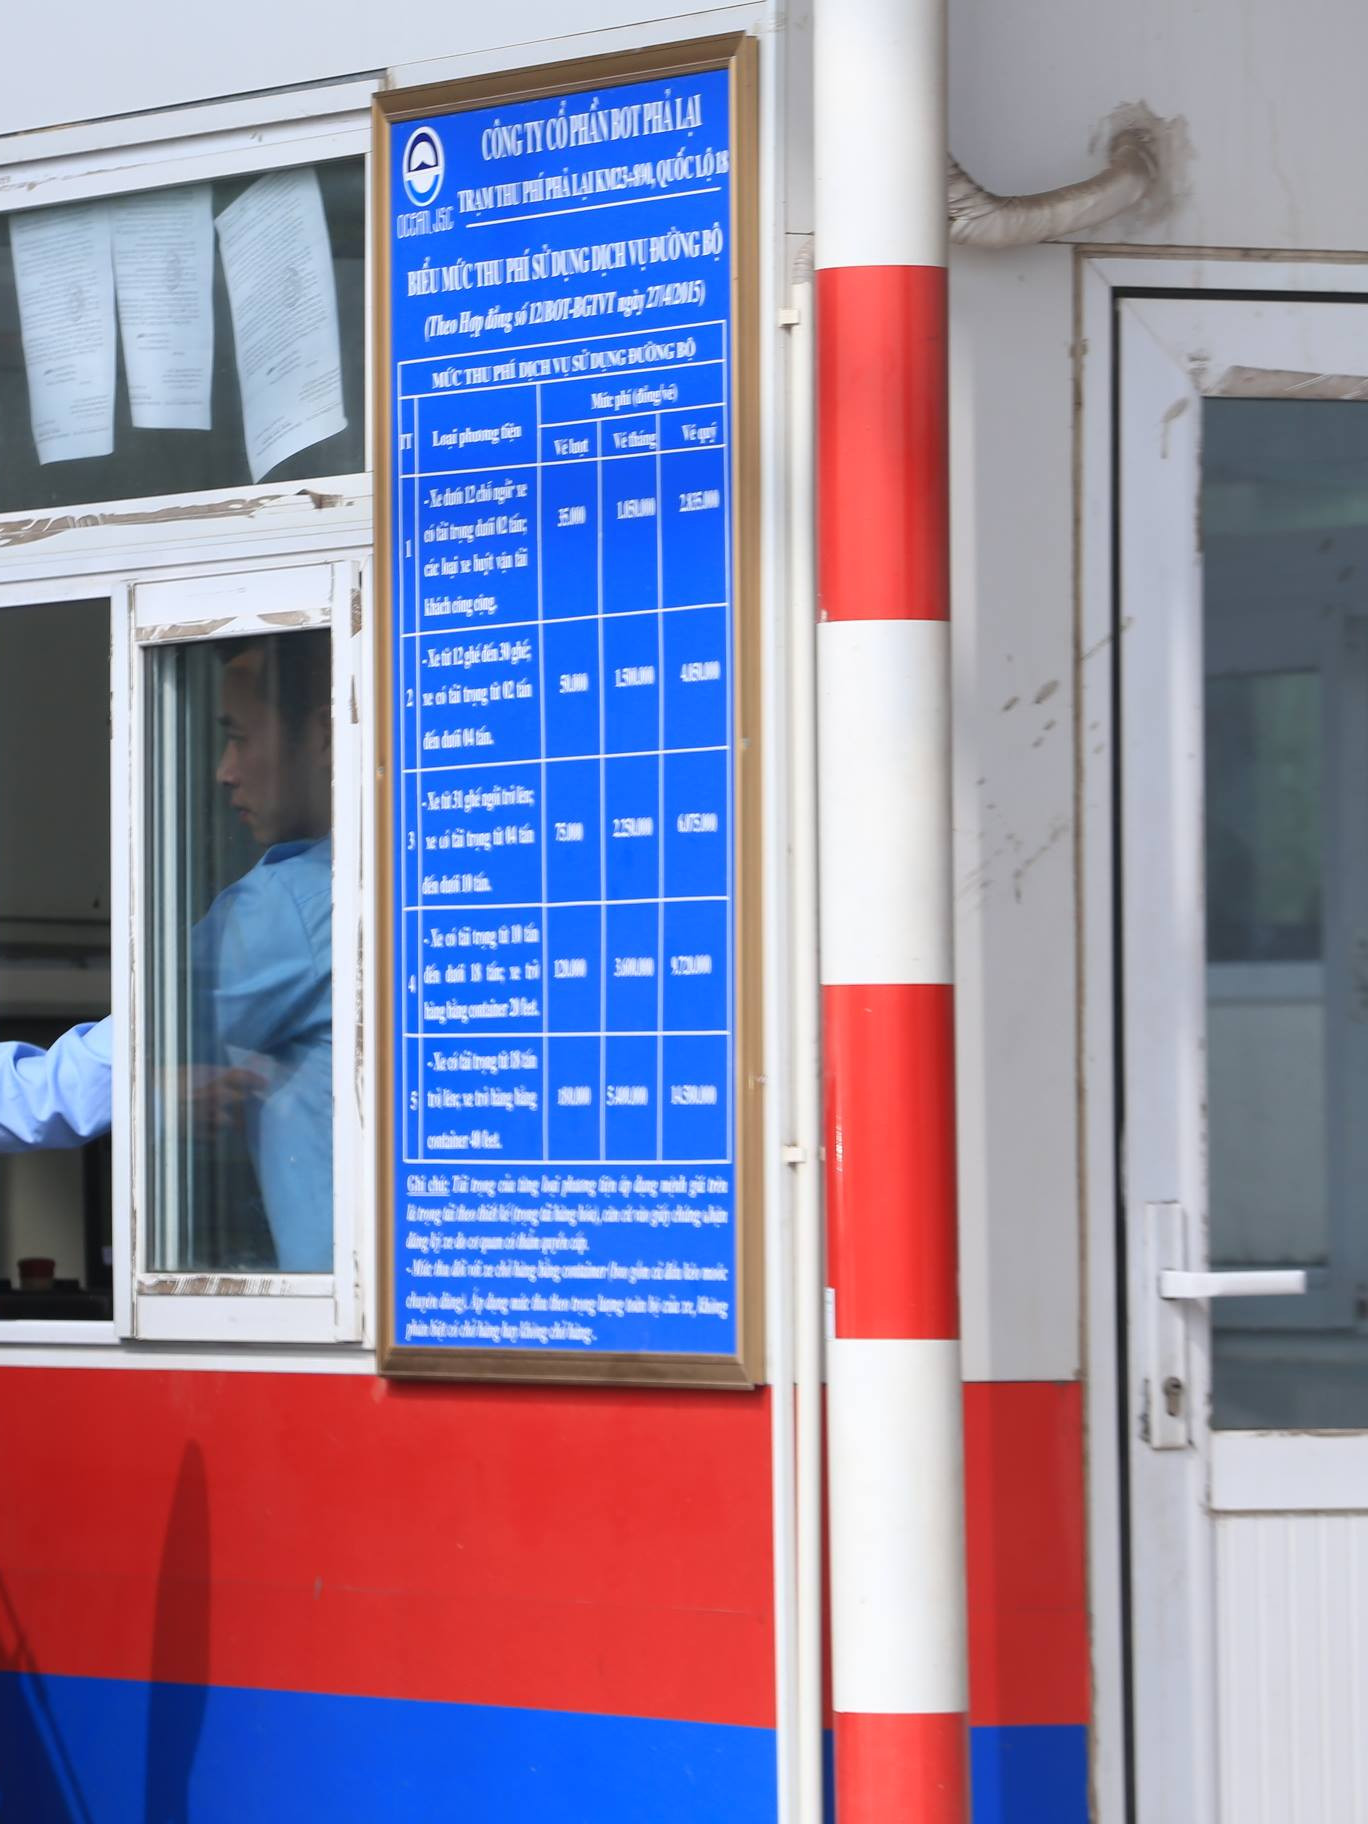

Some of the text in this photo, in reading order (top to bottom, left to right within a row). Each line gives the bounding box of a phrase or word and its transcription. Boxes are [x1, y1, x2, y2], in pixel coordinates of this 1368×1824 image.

[481, 89, 702, 160] CÔNG TY CỔ PHẦN BOT PHẢ LẠI
[457, 186, 493, 216] TRẠM
[494, 182, 520, 207] THU
[522, 173, 544, 203] PHÍ
[545, 169, 571, 200] PHẢ
[572, 171, 595, 200] LẠI
[656, 150, 694, 188] QUỐC
[695, 147, 714, 181] LỘ
[407, 257, 440, 296] BIỂU
[442, 258, 471, 292] MỨC
[473, 259, 503, 287] THU
[505, 249, 529, 283] PHÍ
[551, 247, 589, 281] DỤNG
[590, 241, 626, 276] DỊCH
[627, 238, 647, 271] VỤ
[649, 227, 700, 263] ĐƯỜNG
[701, 222, 724, 261] BỘ
[424, 315, 457, 340] (Theo
[432, 367, 461, 393] MỨC
[463, 366, 490, 389] THU
[492, 359, 516, 381] PHÍ
